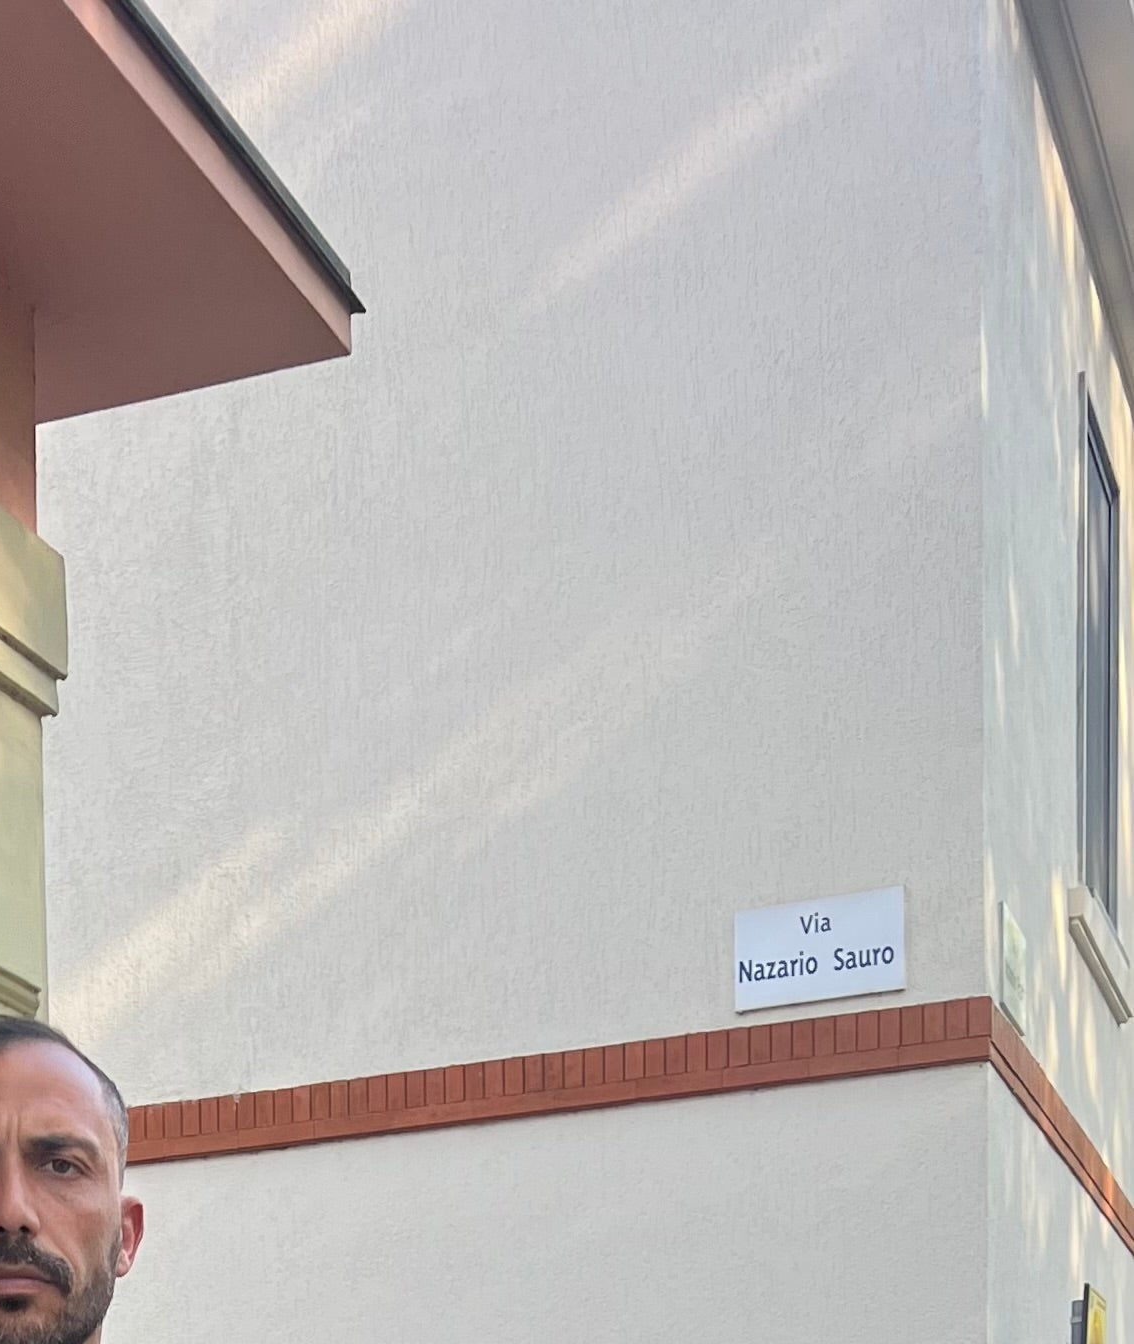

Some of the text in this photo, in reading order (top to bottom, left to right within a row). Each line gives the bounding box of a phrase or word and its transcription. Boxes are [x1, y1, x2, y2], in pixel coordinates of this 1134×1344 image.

[799, 911, 833, 936] Via
[738, 945, 895, 984] Nazario Sauro
